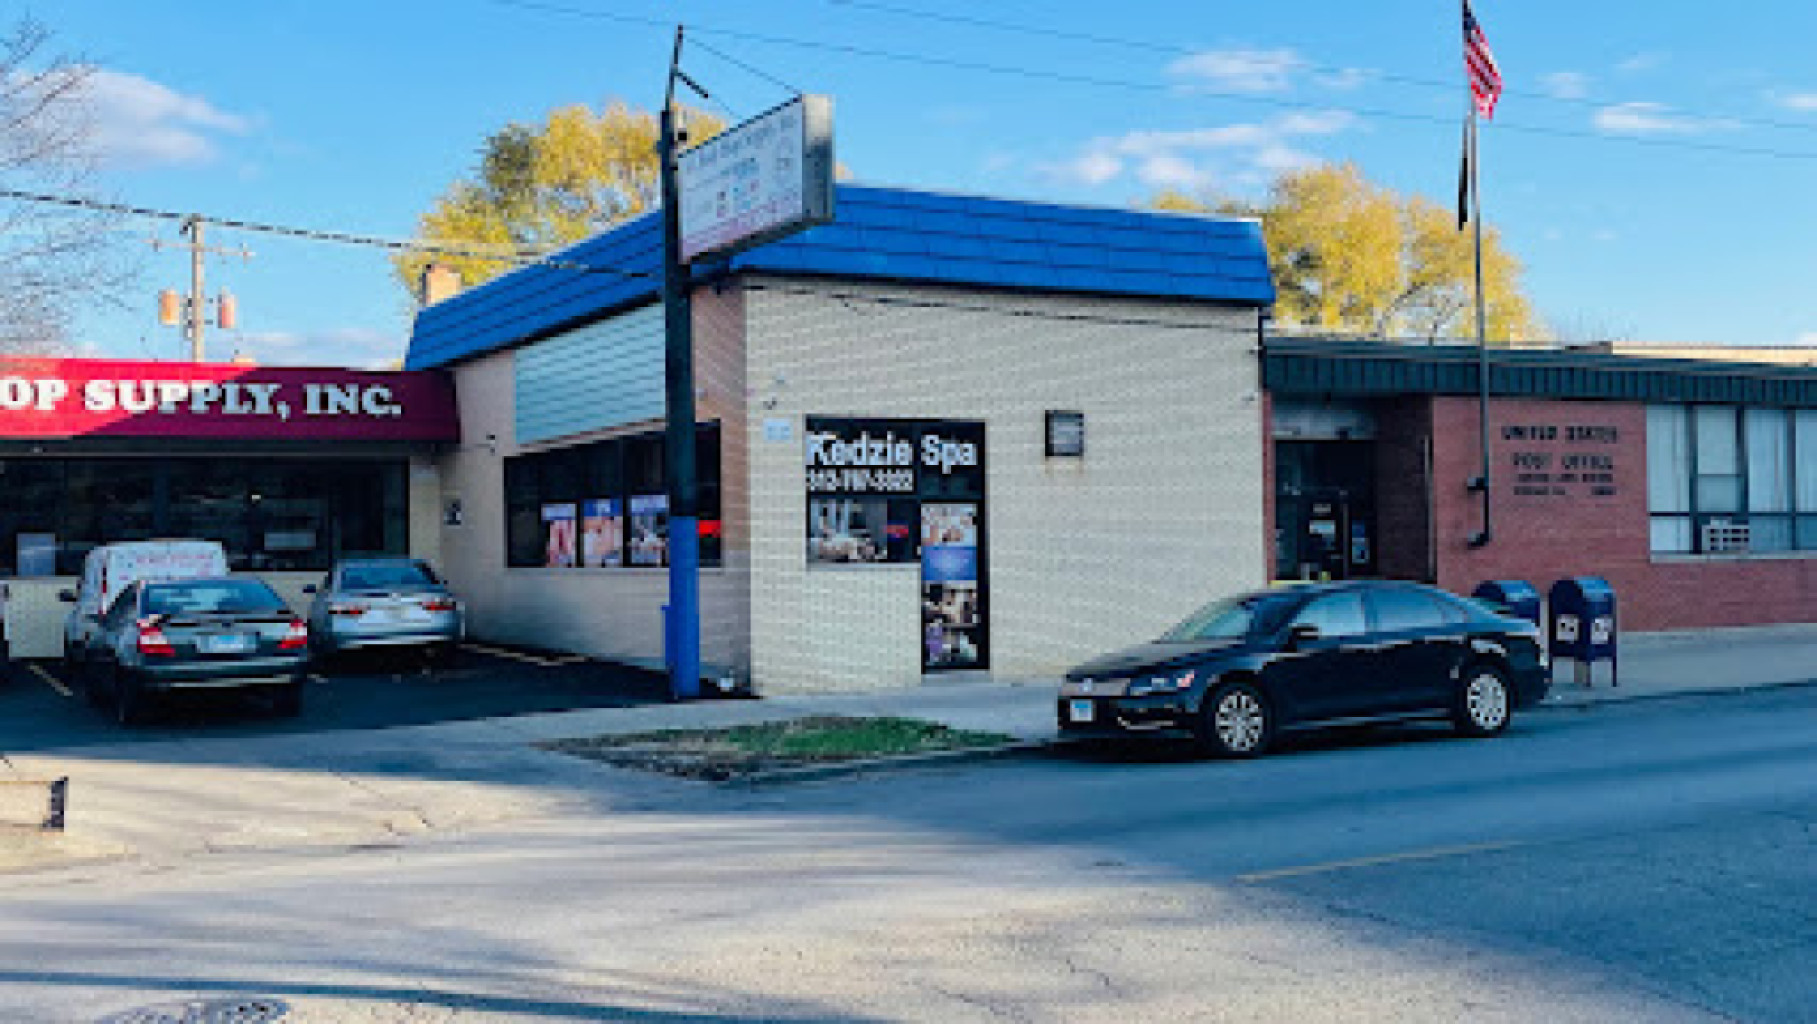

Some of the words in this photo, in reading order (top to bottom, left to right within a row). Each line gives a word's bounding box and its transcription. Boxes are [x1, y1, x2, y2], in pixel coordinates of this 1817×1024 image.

[83, 379, 292, 421] SUPPLY,
[303, 382, 402, 416] INC.
[805, 431, 913, 466] Kedzie
[921, 434, 978, 475] Spa
[1501, 425, 1557, 441] UNITED
